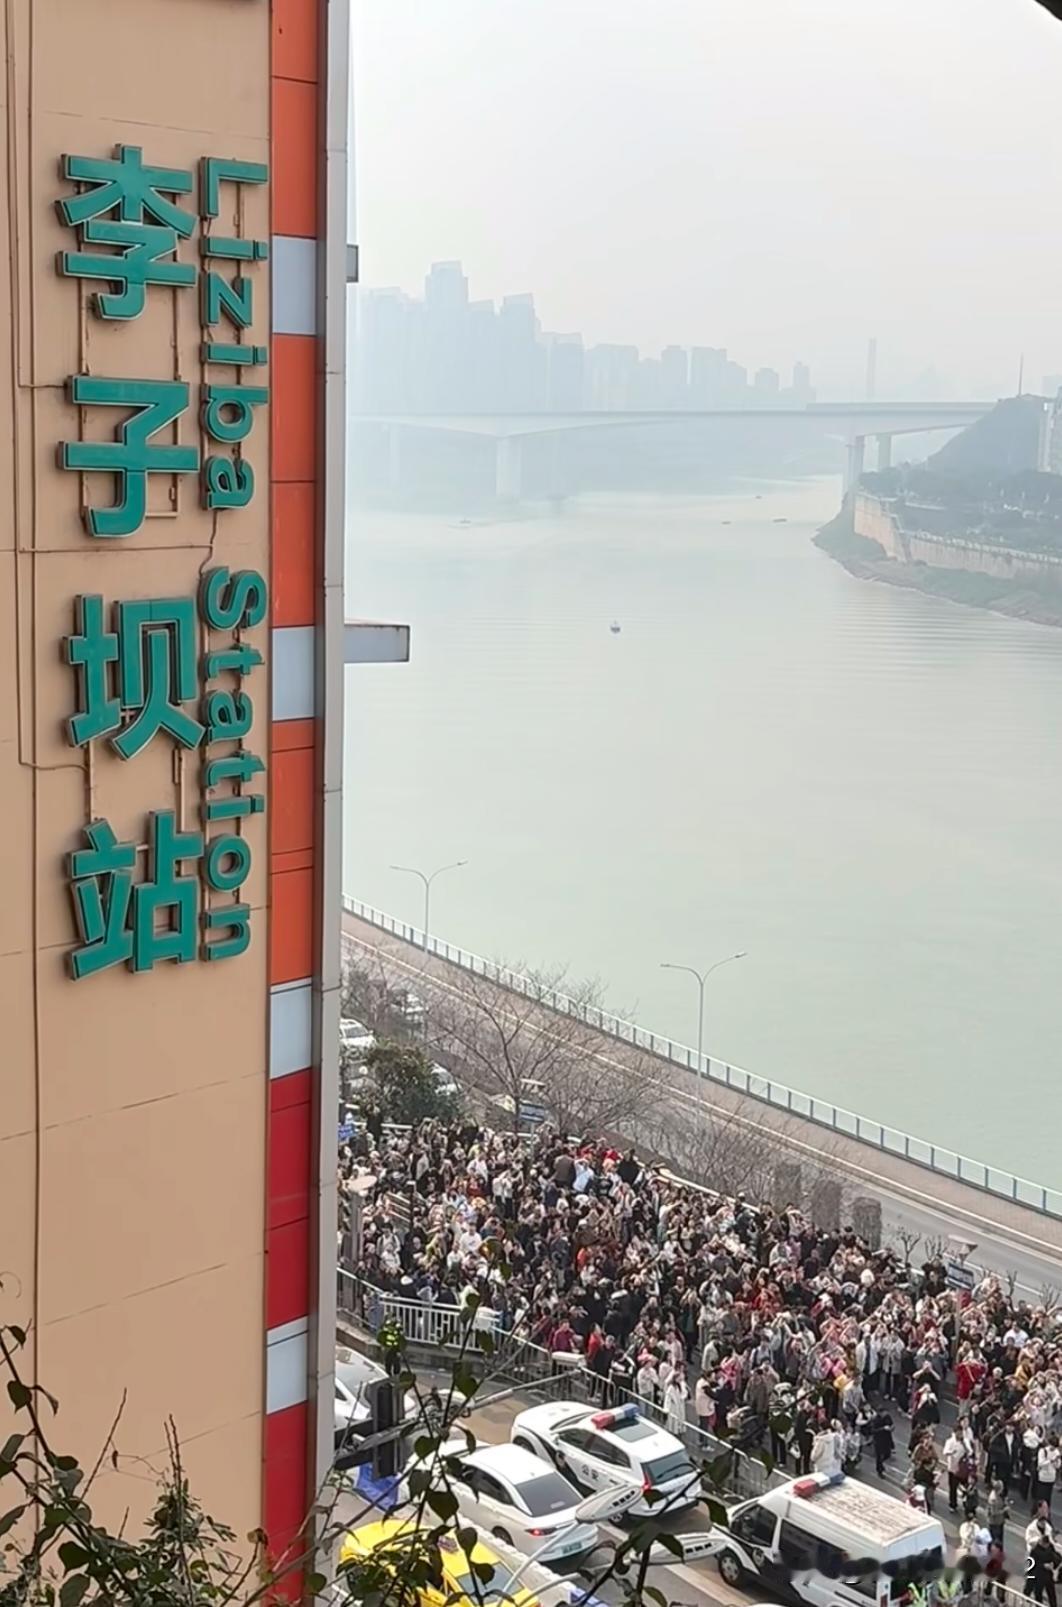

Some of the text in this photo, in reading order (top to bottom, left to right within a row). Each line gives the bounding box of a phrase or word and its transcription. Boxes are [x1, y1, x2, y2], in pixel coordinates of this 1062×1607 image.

[57, 144, 207, 980] 李子坝站
[201, 156, 269, 961] Liziba Station
[582, 1464, 599, 1480] 公安
